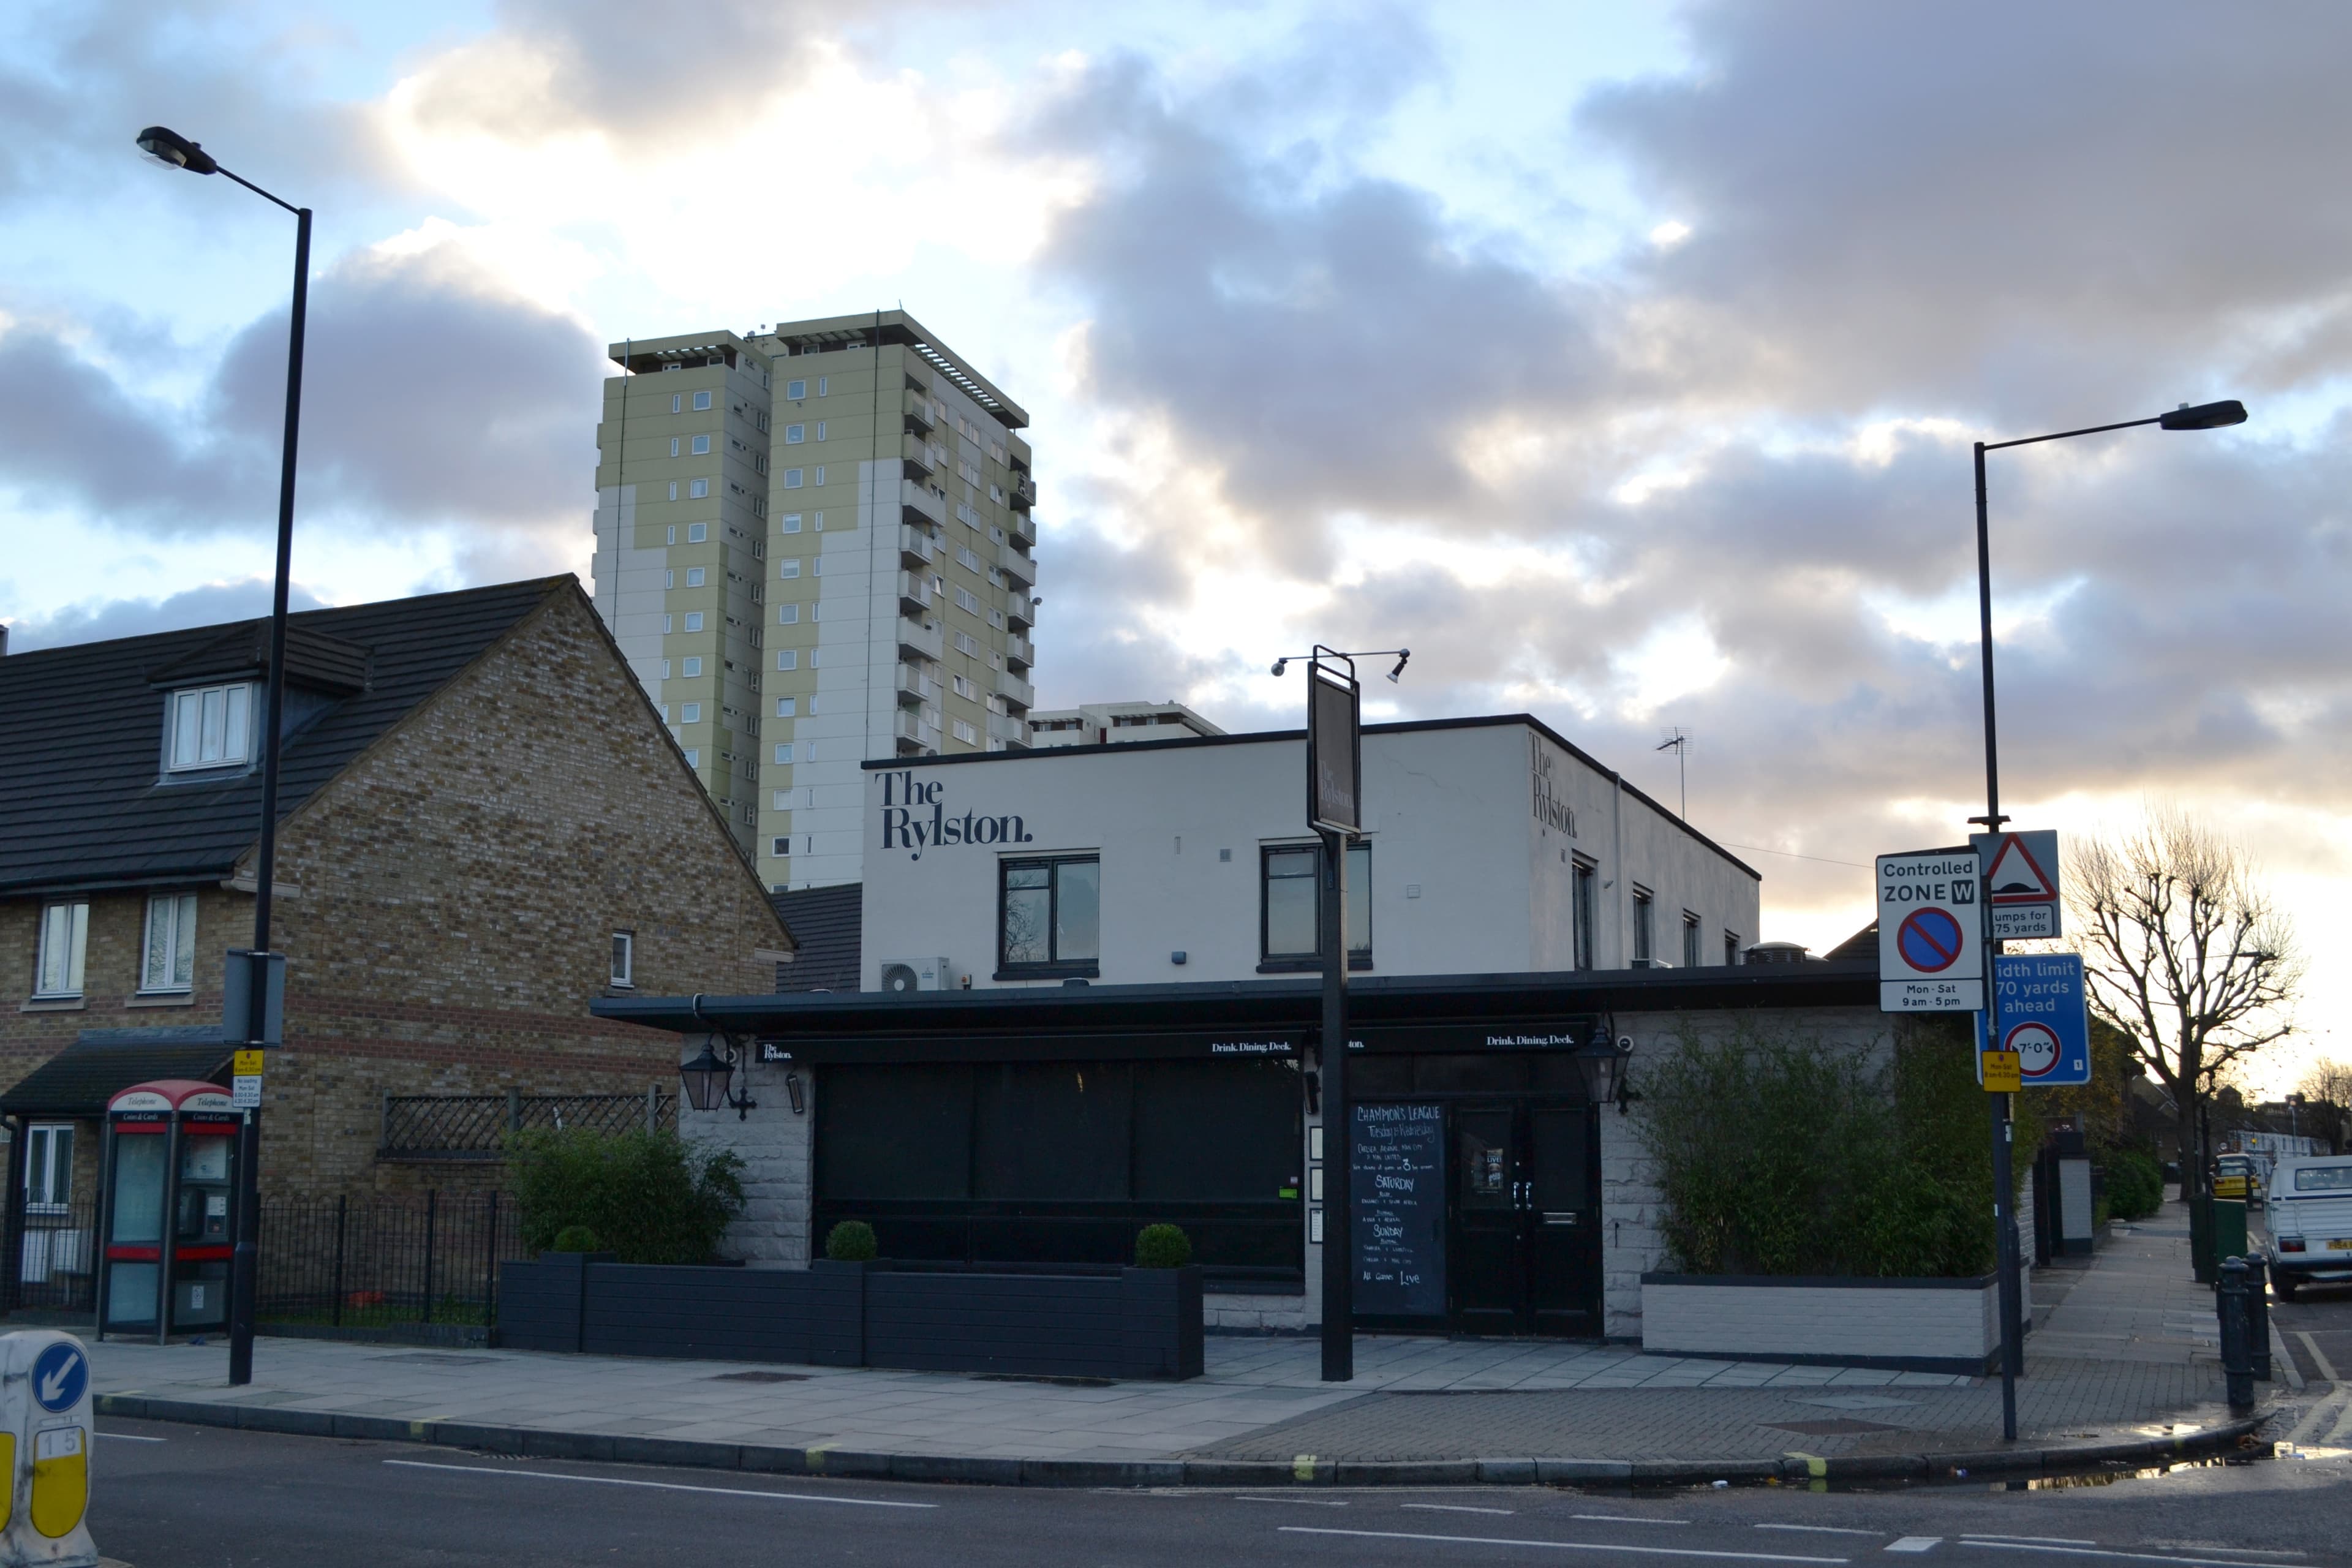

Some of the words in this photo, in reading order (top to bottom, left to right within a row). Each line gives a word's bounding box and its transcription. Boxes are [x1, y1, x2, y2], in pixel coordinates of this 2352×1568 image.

[1529, 732, 1551, 781] The
[1319, 759, 1333, 780] The
[875, 771, 943, 805] The
[1532, 773, 1578, 838] Rylston.
[880, 803, 1033, 861] Rylston.
[1884, 861, 1973, 877] Controlled
[1884, 884, 1946, 902] ZONE
[1953, 883, 1973, 901] W
[1995, 913, 2026, 922] umps
[2030, 911, 2046, 920] for
[1993, 924, 2010, 933] 75
[2014, 922, 2046, 934] yards
[1996, 963, 2030, 977] idth
[2037, 962, 2075, 976] limit
[1907, 985, 1929, 993] Mon
[1937, 984, 1956, 993] Sat
[2023, 979, 2069, 997] yards
[1902, 997, 1909, 1006] 9
[2004, 998, 2055, 1012] ahead
[1212, 1043, 1238, 1052] Drink.
[1239, 1042, 1268, 1053] Dining.
[1269, 1041, 1291, 1050] Deck.
[1348, 1039, 1365, 1048] ton.
[1487, 1036, 1515, 1046] Drink.
[1517, 1035, 1548, 1047] Dining.
[1549, 1035, 1574, 1044] Deck.
[764, 1050, 792, 1061] Rylston.
[128, 1098, 157, 1107] Telephone
[197, 1098, 227, 1107] Telephone
[1408, 1106, 1440, 1121] LEAGUE
[1367, 1123, 1392, 1145] Tuesday
[1403, 1158, 1411, 1171] 3
[1375, 1174, 1414, 1193] SATURDAY
[1373, 1224, 1403, 1238] SUNDAY
[1376, 1272, 1394, 1281] Games
